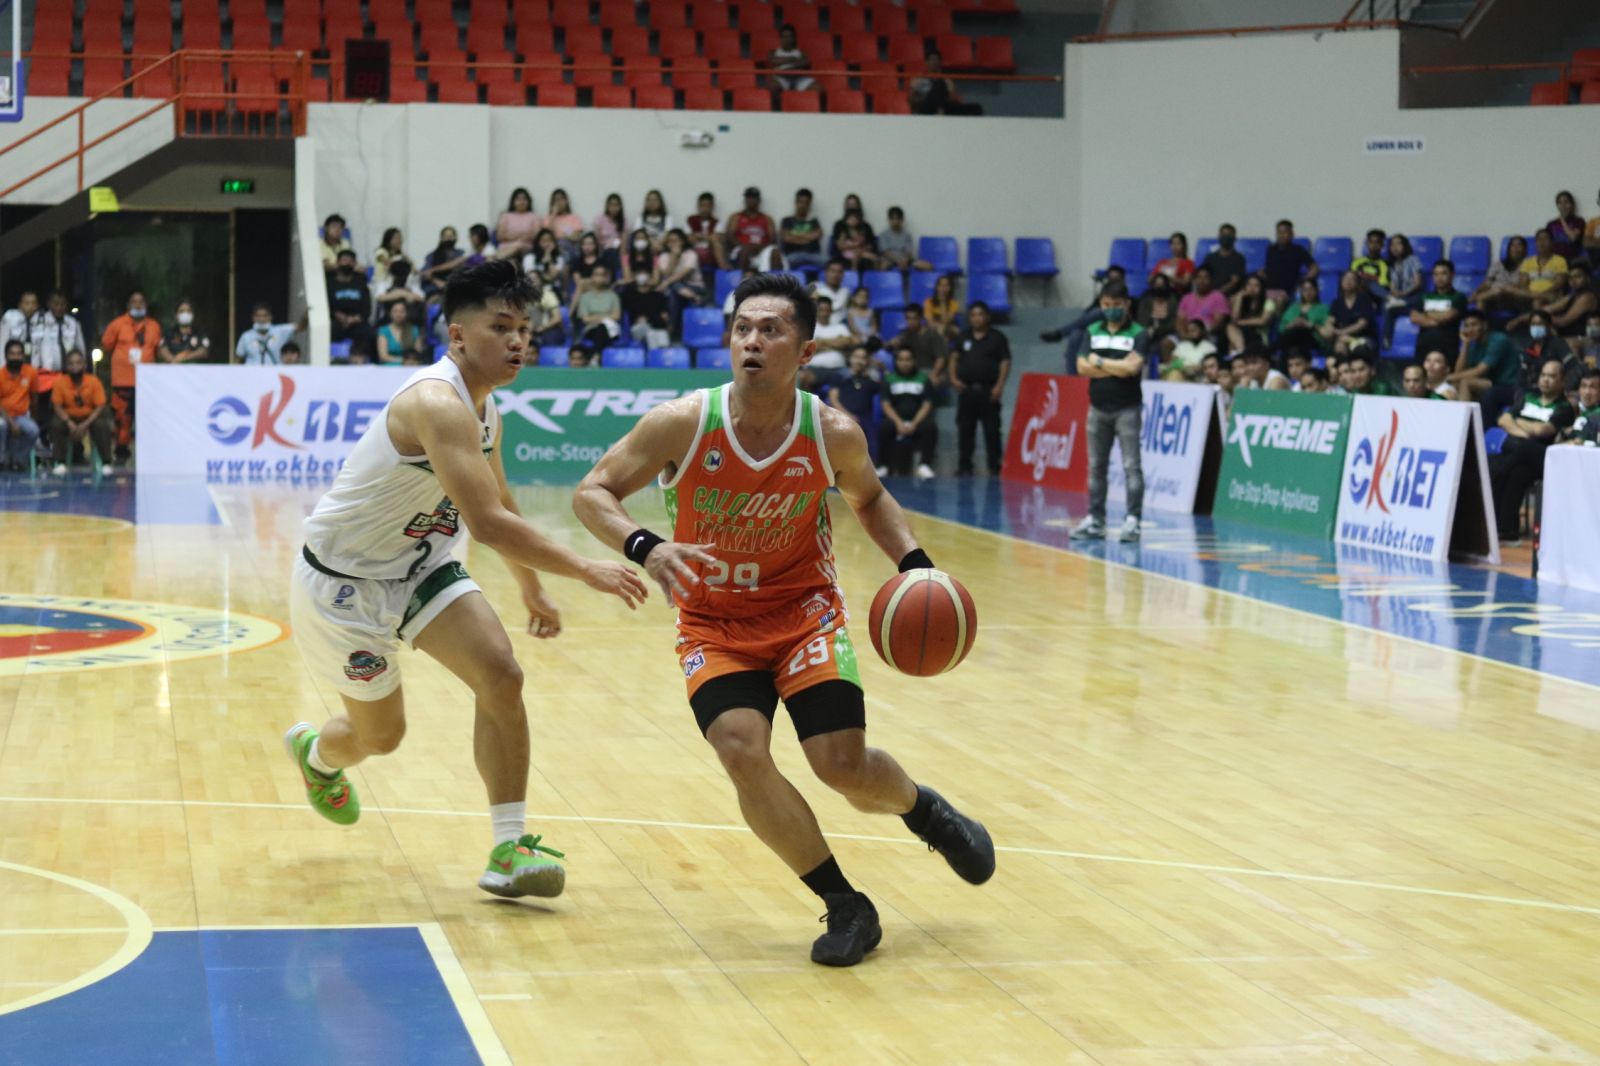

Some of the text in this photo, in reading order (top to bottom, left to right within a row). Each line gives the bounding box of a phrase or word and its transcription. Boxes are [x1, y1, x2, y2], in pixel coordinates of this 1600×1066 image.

[208, 374, 388, 450] OKBE
[493, 389, 700, 434] XTRE
[1020, 416, 1078, 481] Cignal
[1229, 413, 1340, 468] XTREME
[784, 467, 805, 477] ANTA
[693, 486, 816, 520] CALOOCAN
[1341, 520, 1435, 554] www.okbet.com
[703, 560, 760, 592] 29
[788, 637, 829, 676] 29
